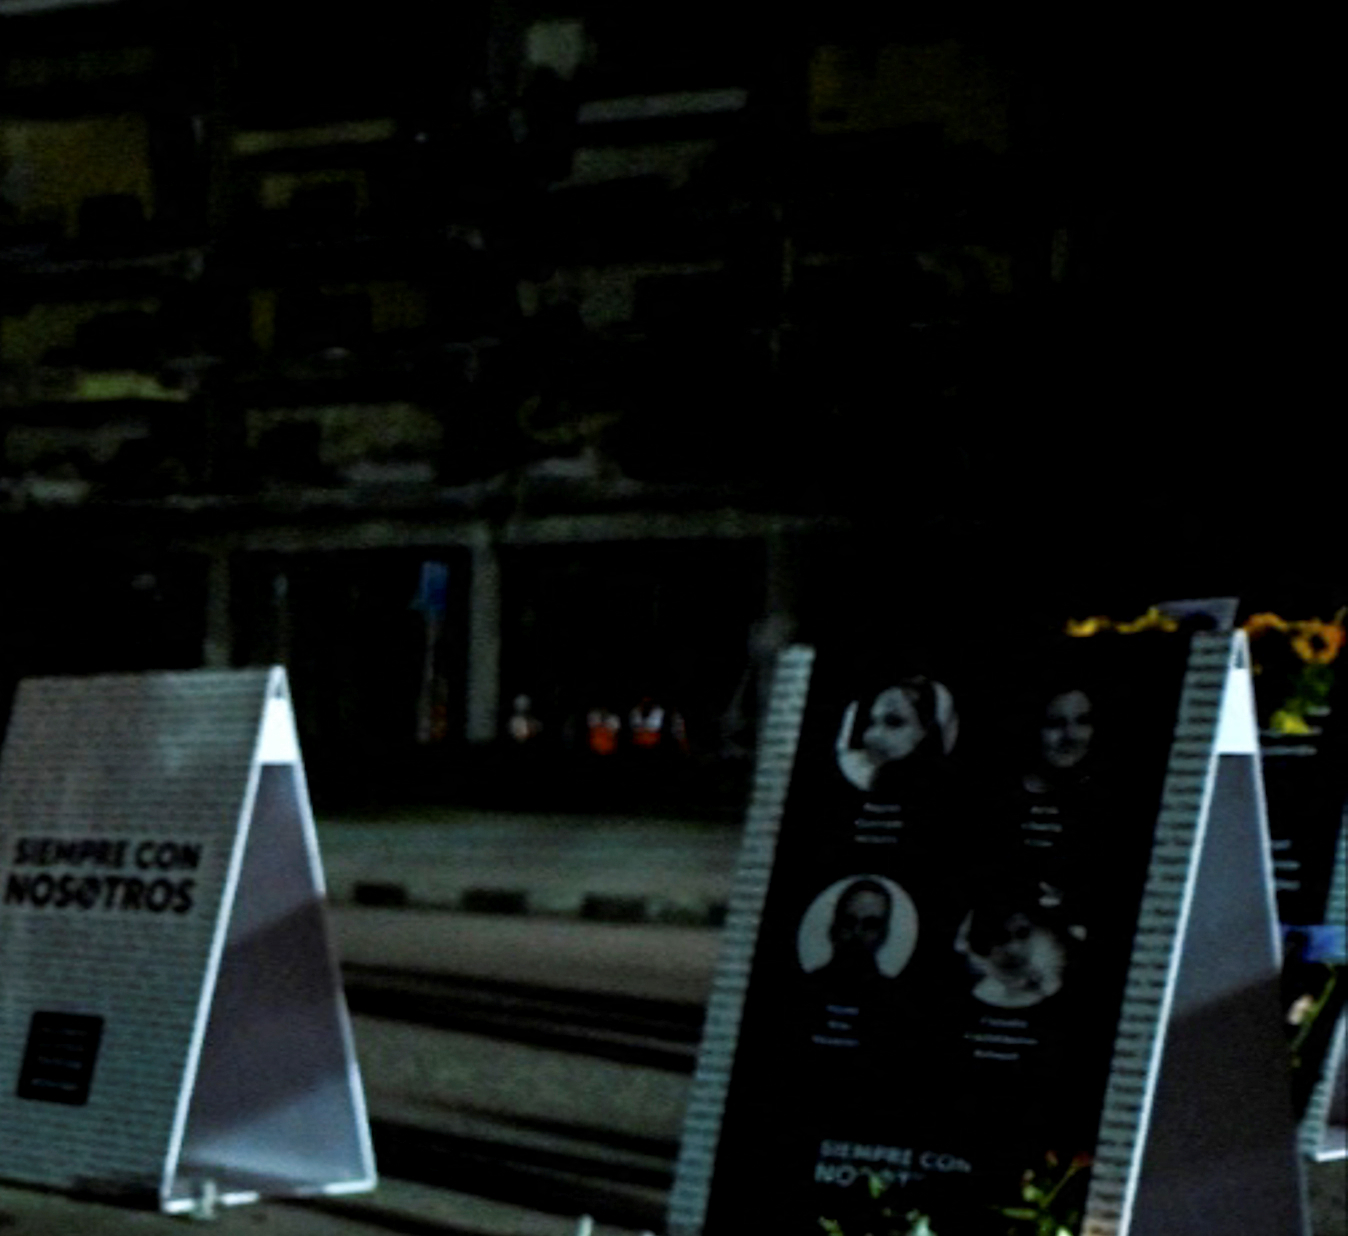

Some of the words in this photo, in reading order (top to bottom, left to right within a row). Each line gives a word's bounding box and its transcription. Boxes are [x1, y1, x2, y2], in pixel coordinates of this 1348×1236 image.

[15, 838, 129, 867] SIEMPRE
[136, 841, 202, 870] CON
[5, 874, 195, 913] NOSOTROS
